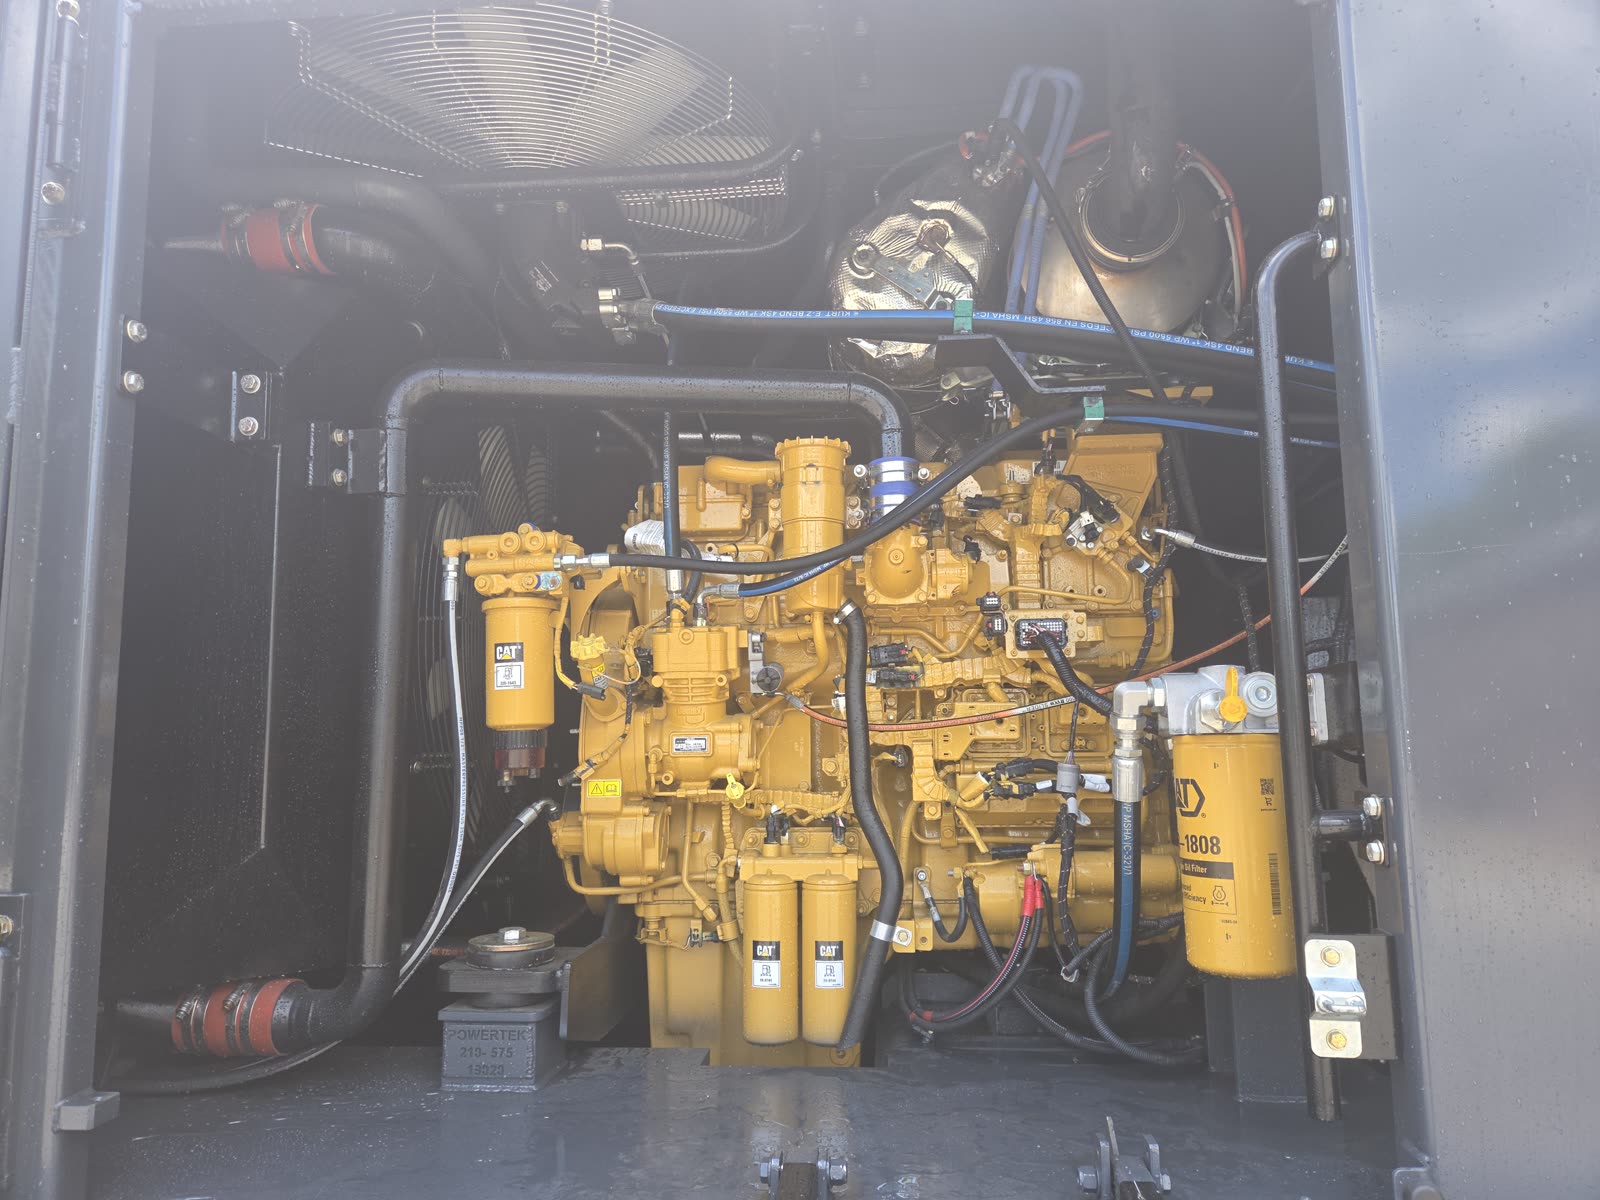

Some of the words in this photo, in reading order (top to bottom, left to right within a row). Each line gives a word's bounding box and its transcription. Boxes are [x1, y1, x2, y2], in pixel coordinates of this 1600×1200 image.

[662, 305, 697, 315] EXCEEDS
[992, 312, 1020, 320] MSHA
[1024, 315, 1044, 323] 4SH
[1046, 317, 1062, 325] 856
[1064, 319, 1078, 327] EN
[1130, 329, 1147, 337] PSI
[1149, 331, 1172, 341] 5500
[1174, 335, 1190, 344] WP
[1204, 340, 1223, 348] 4SK
[1225, 344, 1254, 355] BEND
[1284, 355, 1305, 364] KUR
[496, 645, 517, 660] CAT
[1123, 814, 1132, 840] MSHA
[1178, 834, 1222, 855] -1808
[1123, 842, 1132, 876] IC-321/1
[1191, 864, 1208, 874] Filter
[756, 945, 773, 957] CAT
[819, 945, 836, 957] CAT
[447, 1029, 528, 1041] POWERTEK
[490, 1047, 514, 1058] 575
